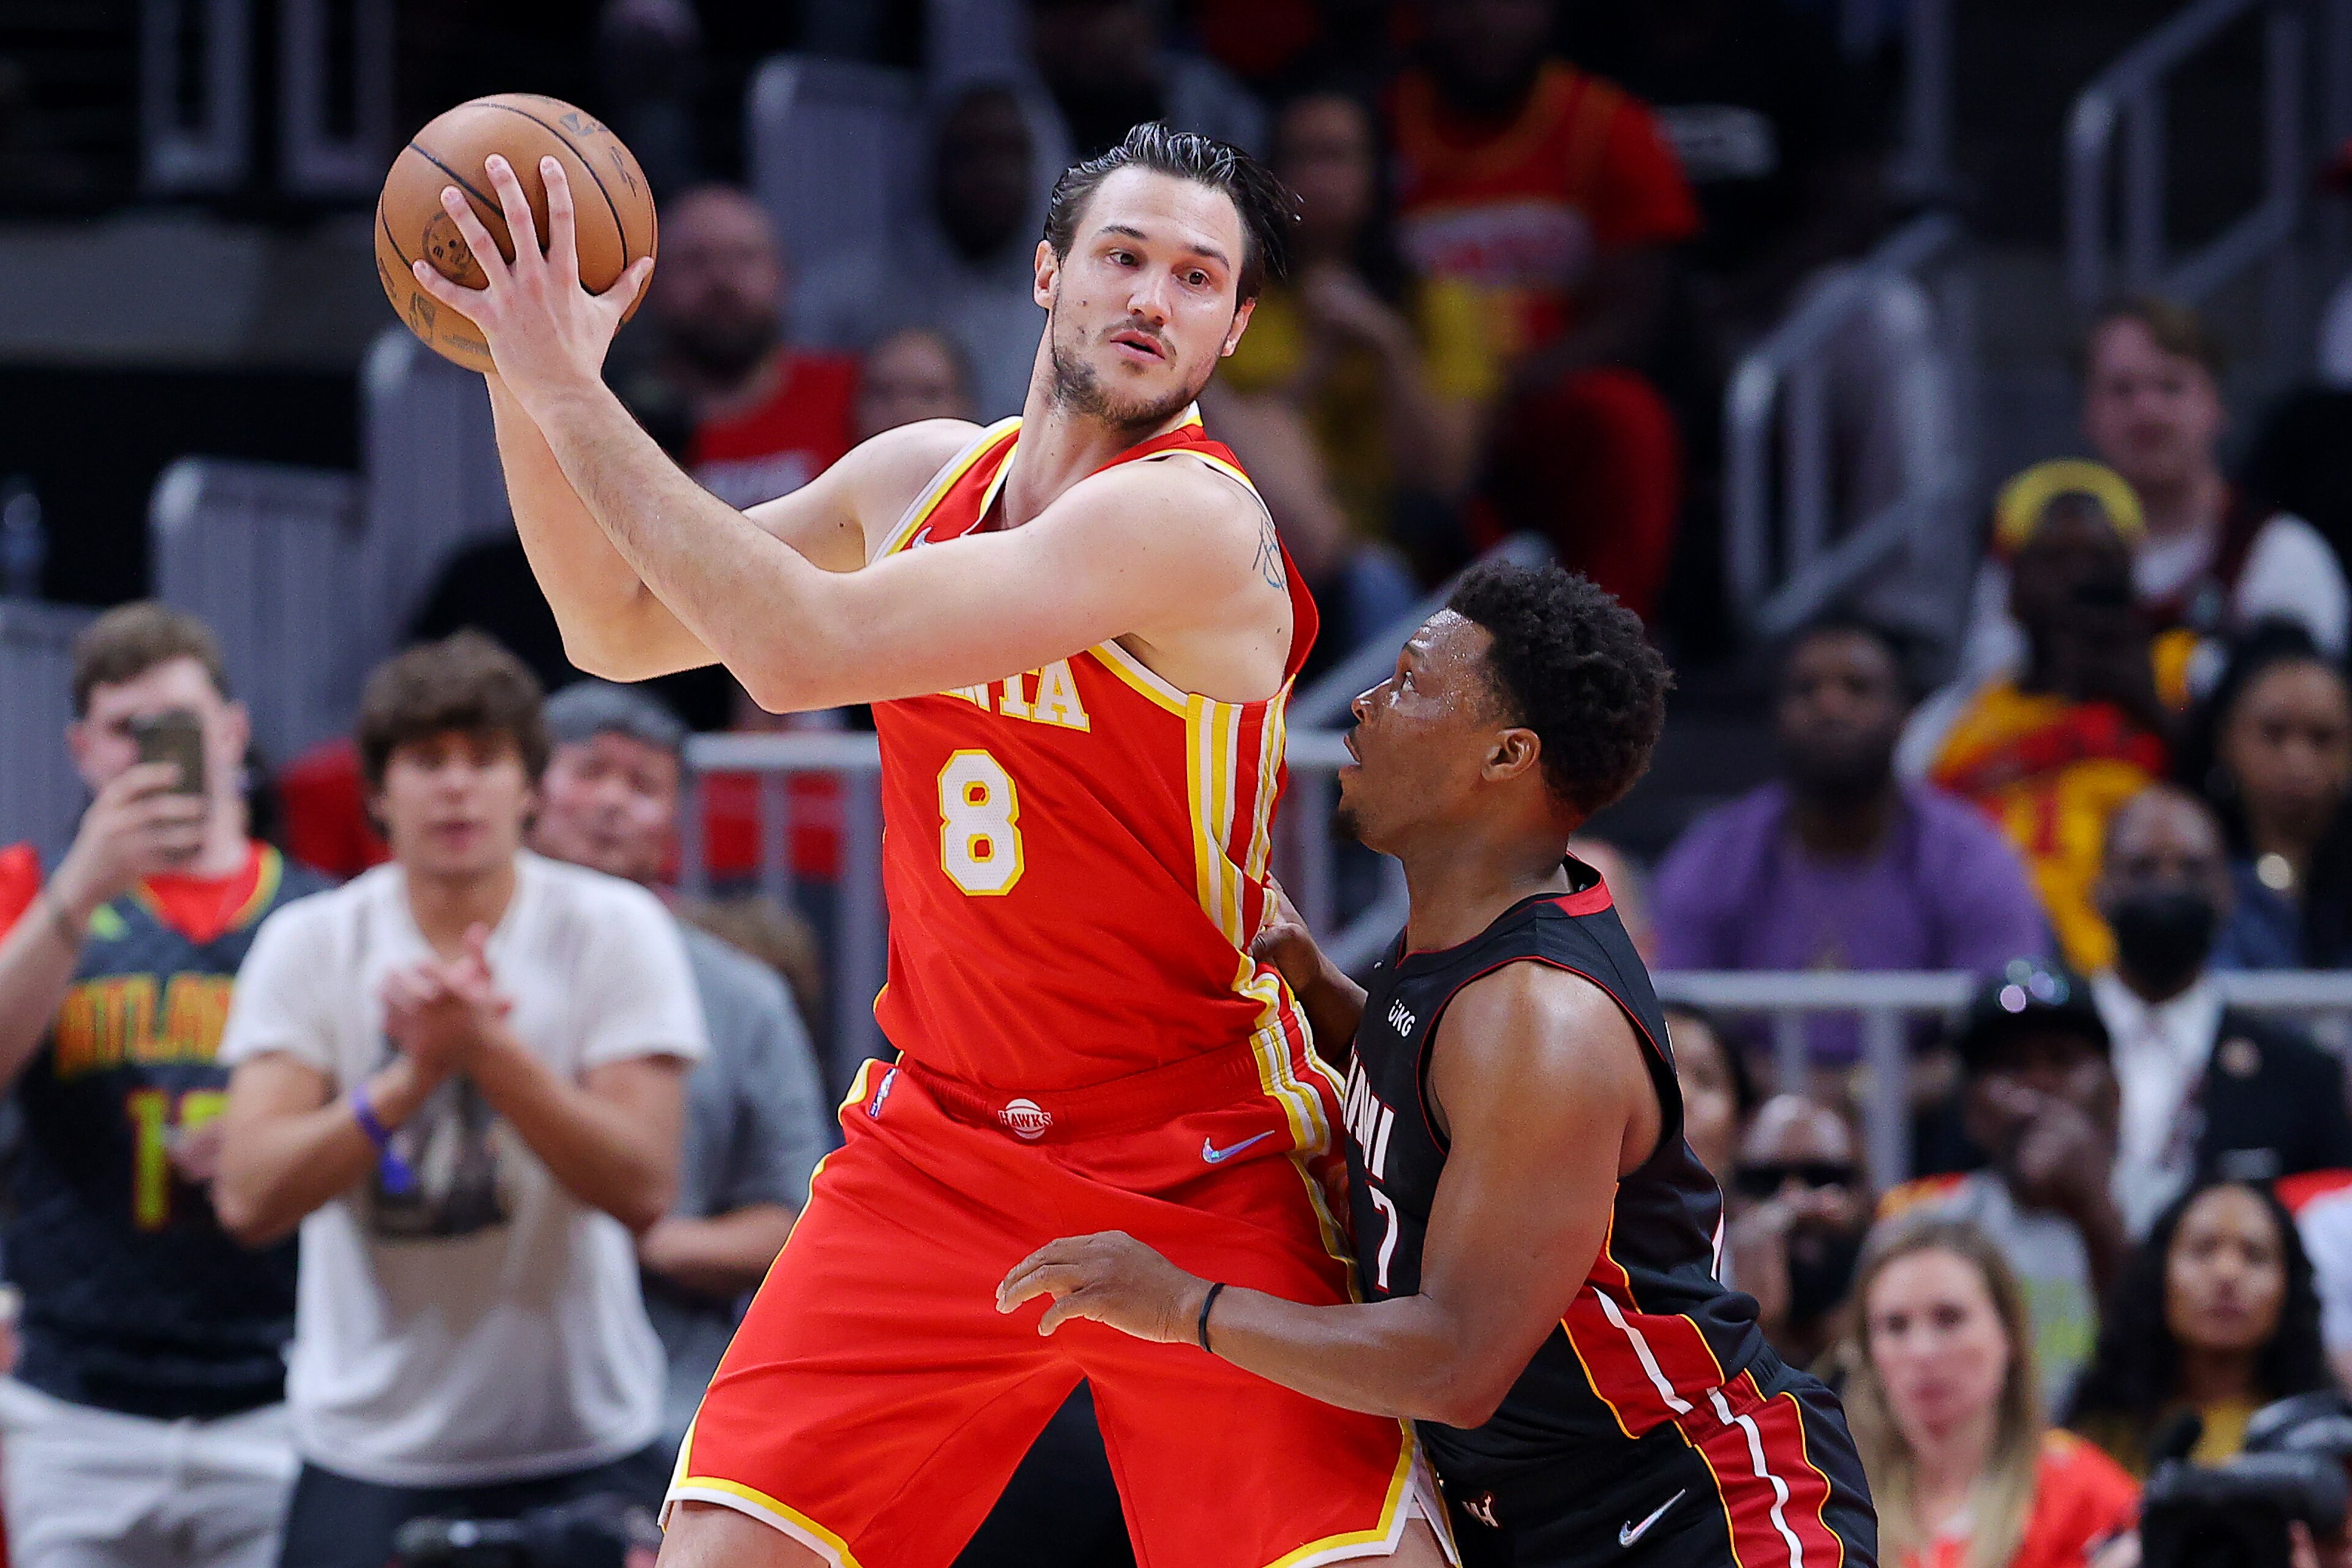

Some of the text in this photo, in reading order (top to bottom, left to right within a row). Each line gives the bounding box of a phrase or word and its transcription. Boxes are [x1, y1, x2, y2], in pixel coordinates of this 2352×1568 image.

[937, 748, 1025, 896] 8
[997, 1110, 1053, 1127] HAWKS
[1343, 1042, 1398, 1185] IAMI
[1365, 1179, 1398, 1294] 7
